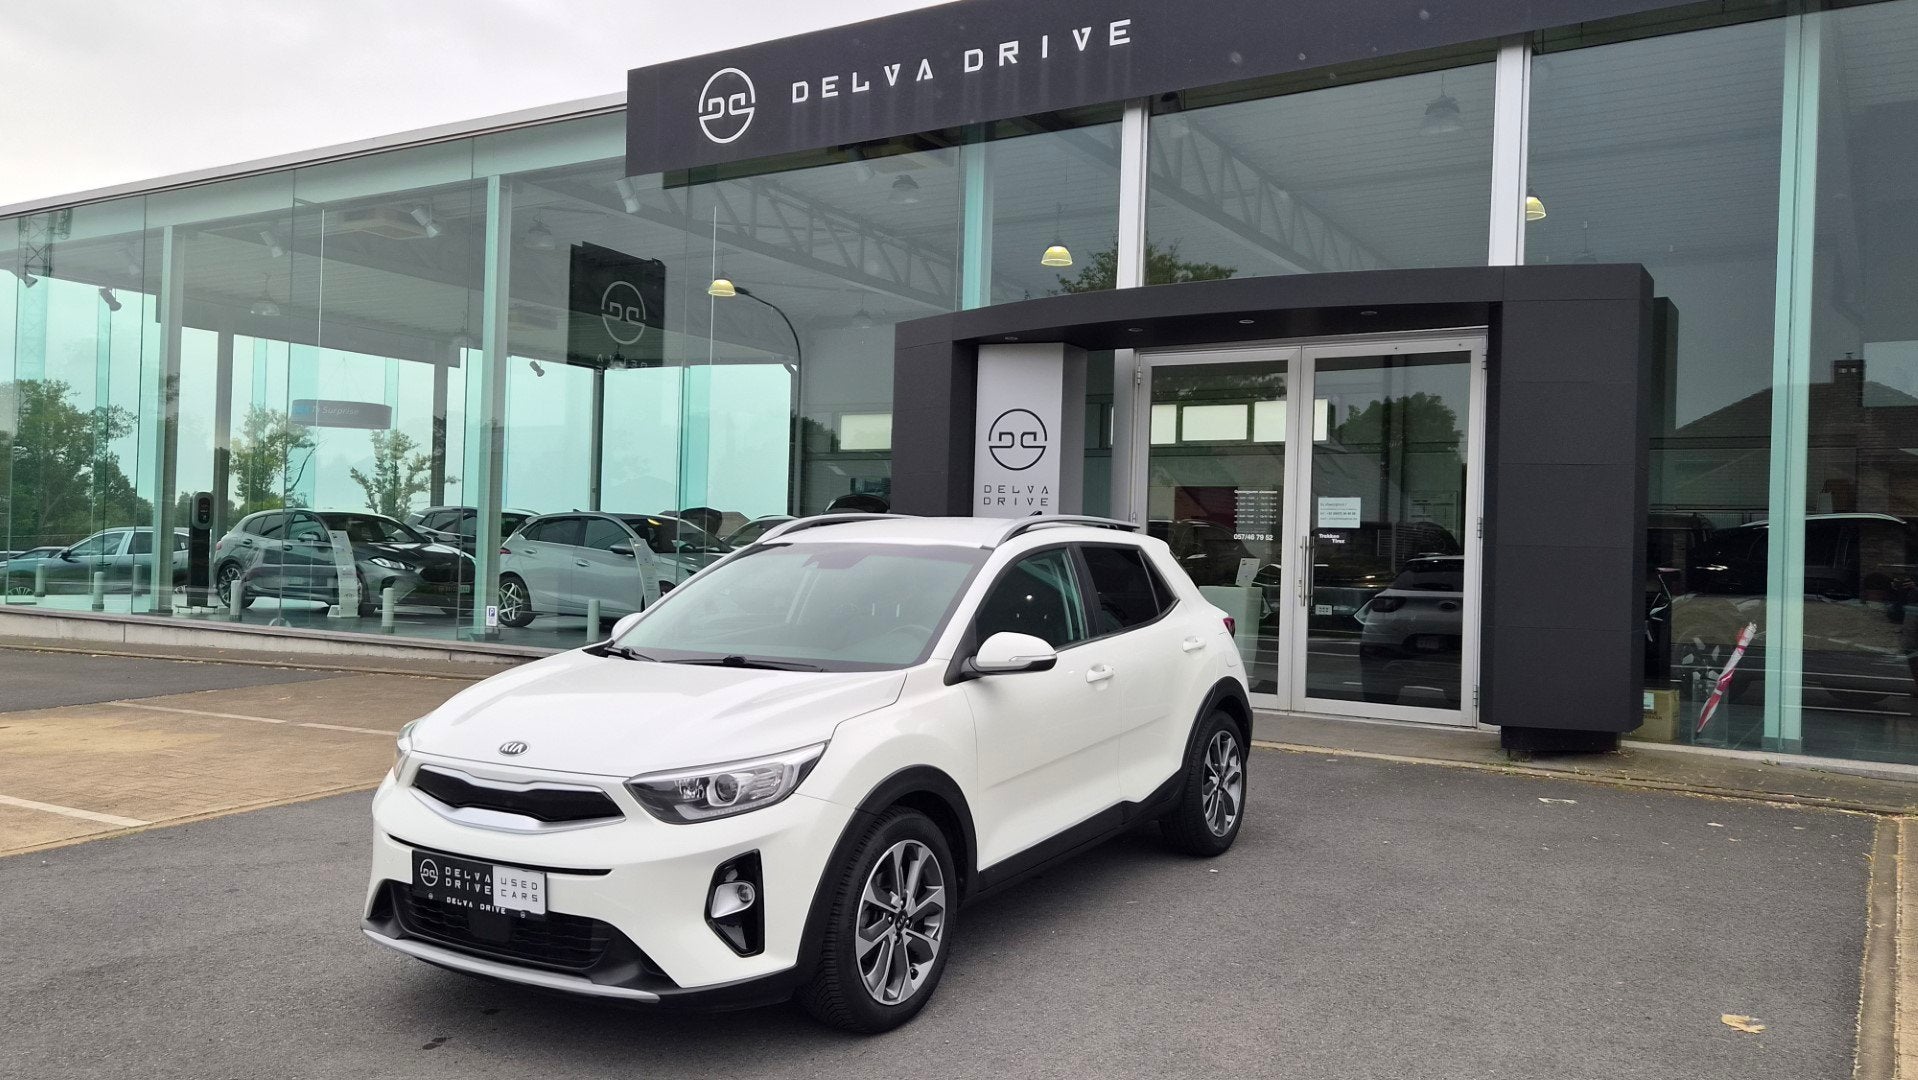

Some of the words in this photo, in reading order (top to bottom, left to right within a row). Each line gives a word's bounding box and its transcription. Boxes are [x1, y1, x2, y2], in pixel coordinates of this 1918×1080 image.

[791, 58, 933, 104] DELVA
[963, 18, 1132, 74] DRIVE
[983, 485, 1049, 495] DELVA
[983, 497, 1049, 506] DRIVE
[1256, 533, 1265, 541] 79
[501, 742, 524, 753] KIA
[445, 866, 492, 884] DELVA
[445, 877, 492, 895] DRIVE
[500, 877, 538, 891] USED
[500, 889, 538, 903] CARS
[446, 896, 473, 908] DELVA
[479, 903, 506, 915] DRIVE
